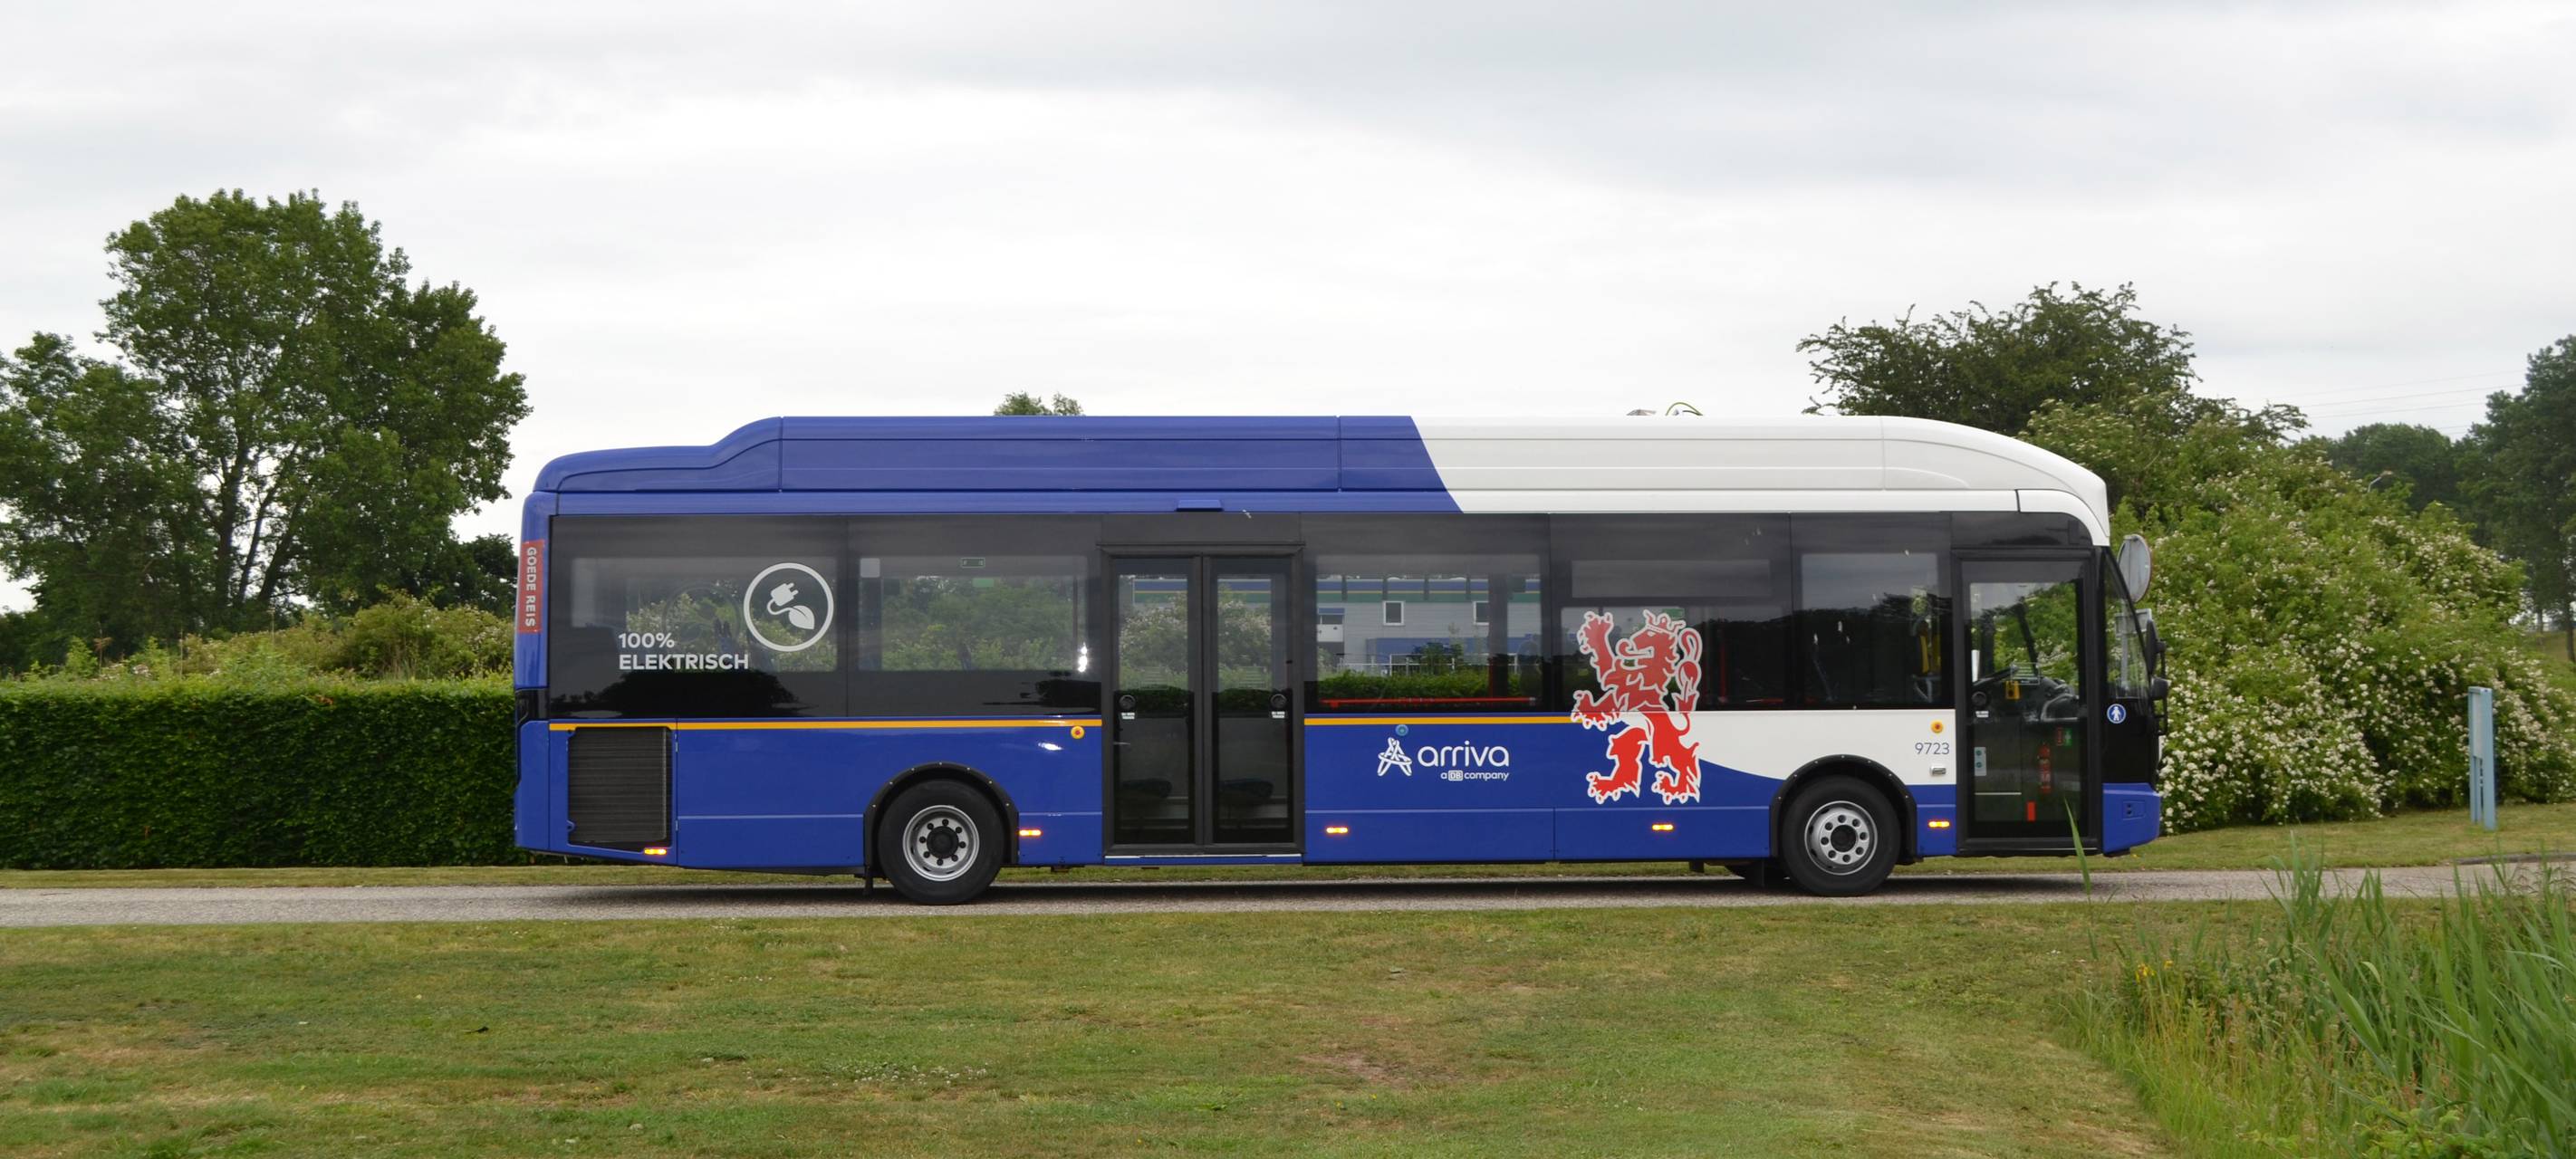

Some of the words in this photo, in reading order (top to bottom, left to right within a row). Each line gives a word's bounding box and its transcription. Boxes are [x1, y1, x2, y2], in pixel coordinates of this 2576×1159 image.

[526, 547, 537, 591] GOEDE
[525, 595, 536, 627] REIS
[618, 632, 675, 648] 100%
[619, 654, 749, 670] ELEKTRISCH
[1418, 740, 1510, 767] arriva
[1915, 742, 1949, 754] 9723
[1440, 771, 1447, 780] a
[1449, 771, 1463, 781] DB
[1464, 771, 1510, 781] company
